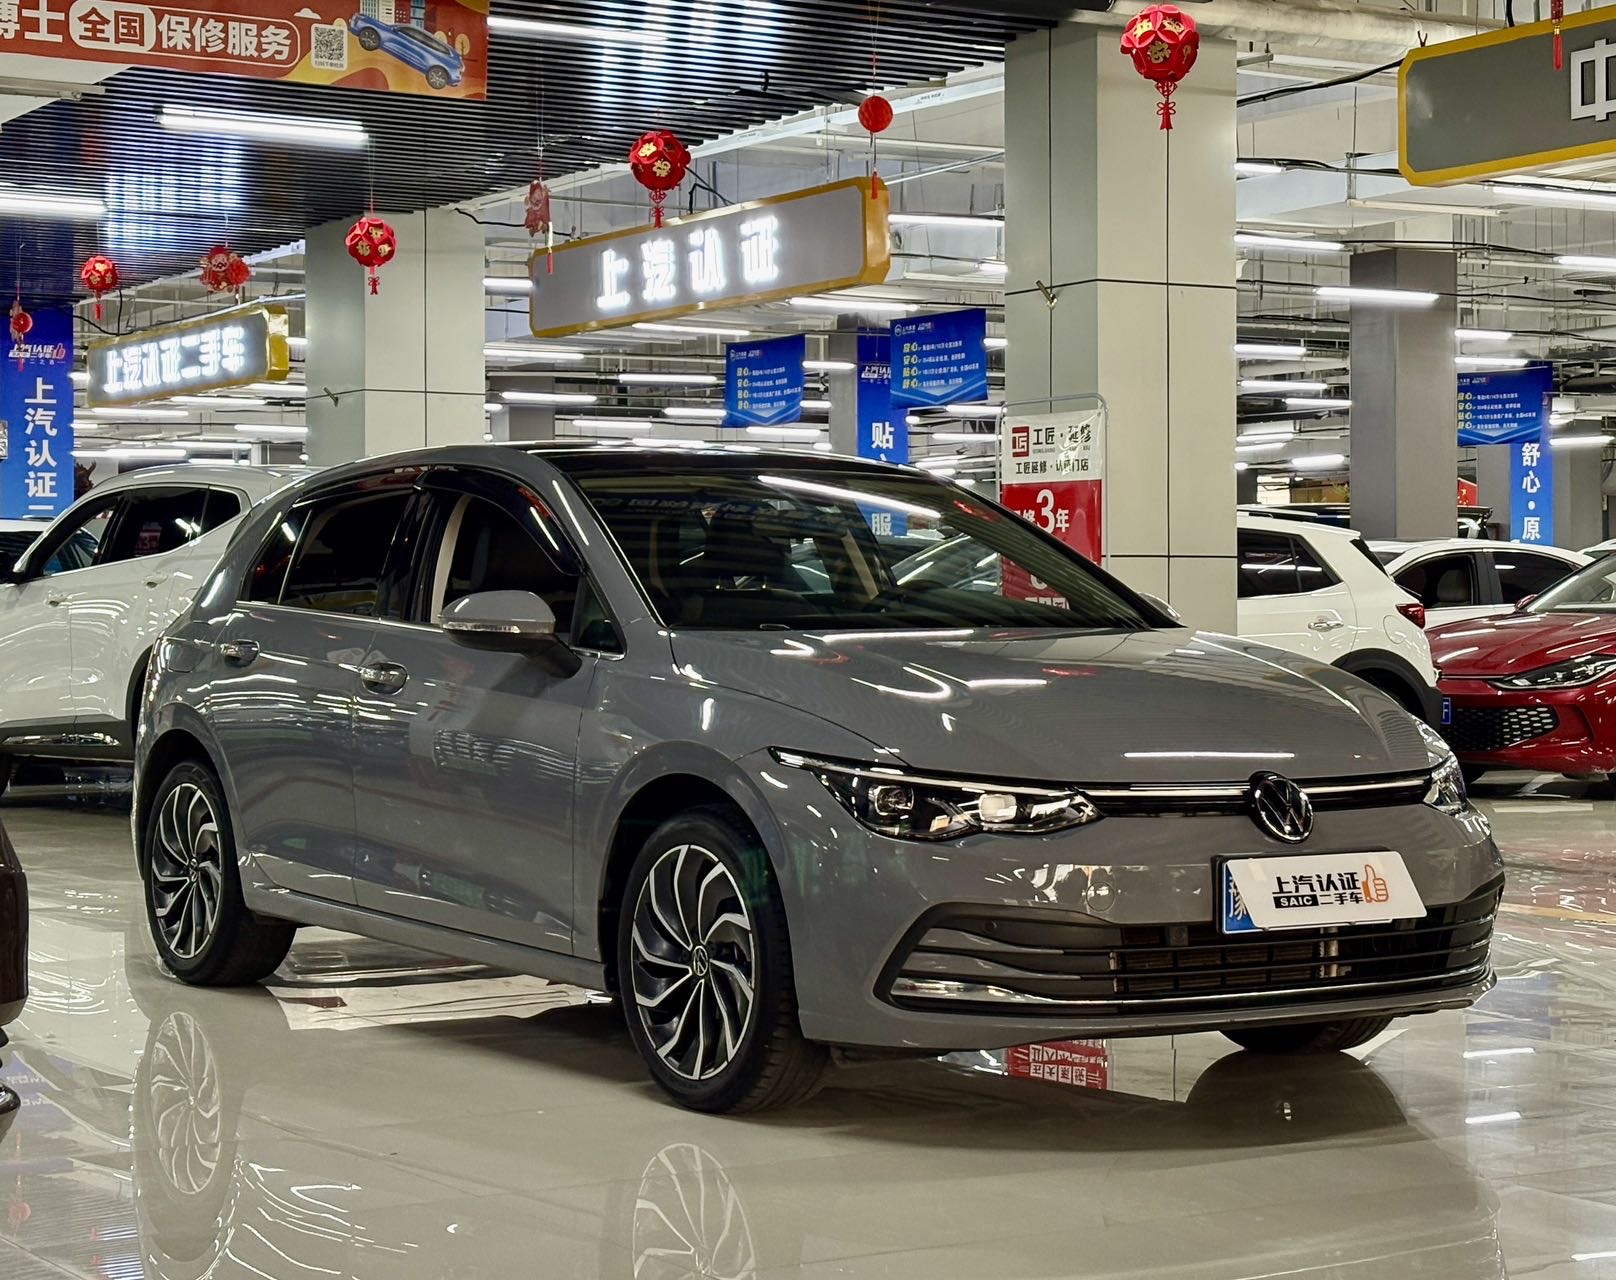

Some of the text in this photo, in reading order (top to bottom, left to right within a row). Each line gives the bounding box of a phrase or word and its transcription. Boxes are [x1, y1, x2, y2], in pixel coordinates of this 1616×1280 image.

[78, 6, 145, 46] 全国
[157, 15, 293, 62] 保修服务
[596, 215, 780, 309] 上汽认证
[103, 326, 246, 394] 上汽认证二手车
[871, 512, 893, 536] 服
[1272, 871, 1361, 895] 上汽认证
[1279, 895, 1314, 908] SAIC
[1319, 891, 1364, 906] 二手车
